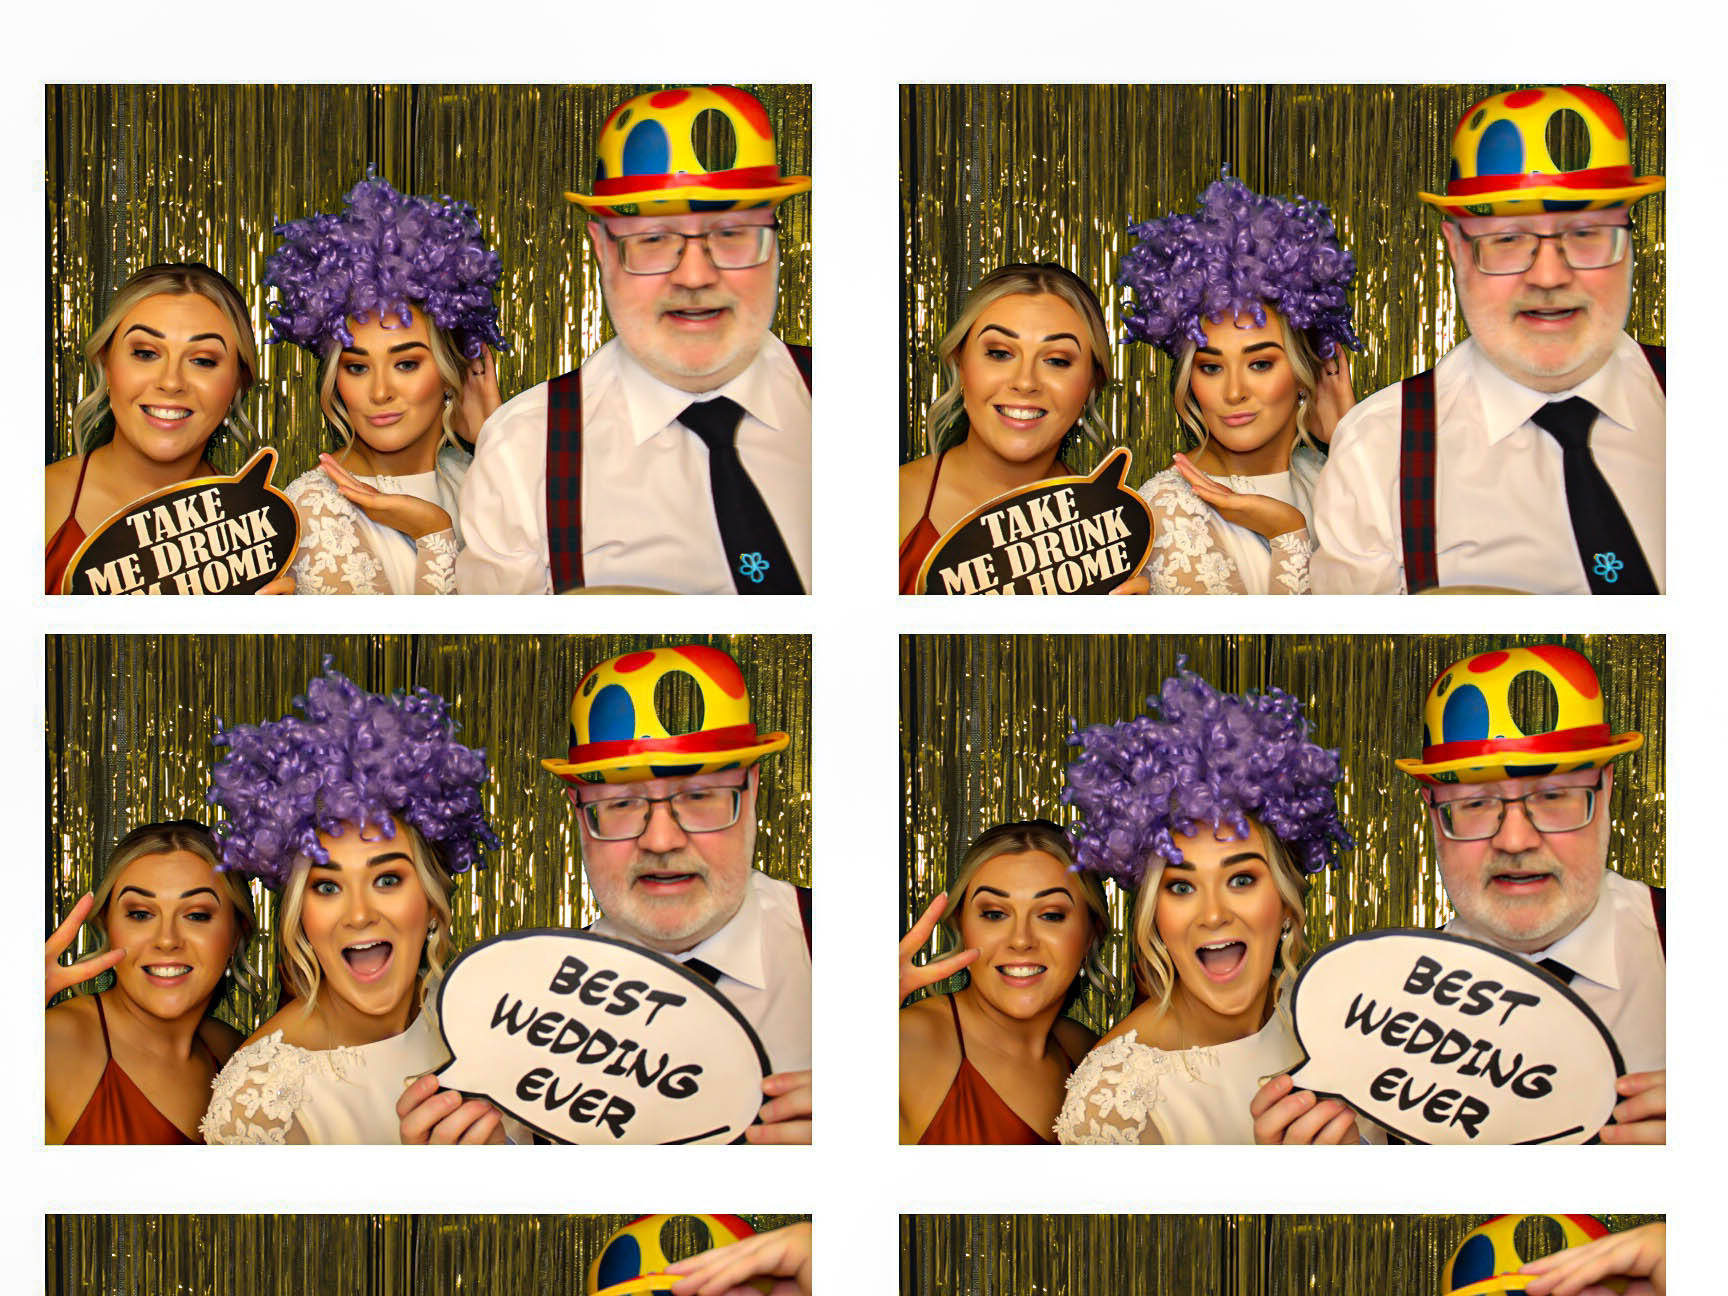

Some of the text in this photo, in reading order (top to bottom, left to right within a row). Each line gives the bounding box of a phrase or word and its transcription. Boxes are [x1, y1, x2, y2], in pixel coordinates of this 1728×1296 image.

[84, 505, 278, 595] ME DRUNK
[127, 487, 225, 549] TAKE
[938, 505, 1132, 595] ME DRUNK
[981, 487, 1079, 549] TAKE
[173, 541, 277, 595] HOME
[1027, 541, 1131, 595] HOME
[549, 955, 687, 1026] BEST
[1403, 955, 1541, 1026] BEST
[490, 993, 703, 1099] WEDDING
[1344, 993, 1557, 1099] WEDDING
[516, 1067, 636, 1139] EVER
[1370, 1067, 1490, 1139] EVER
